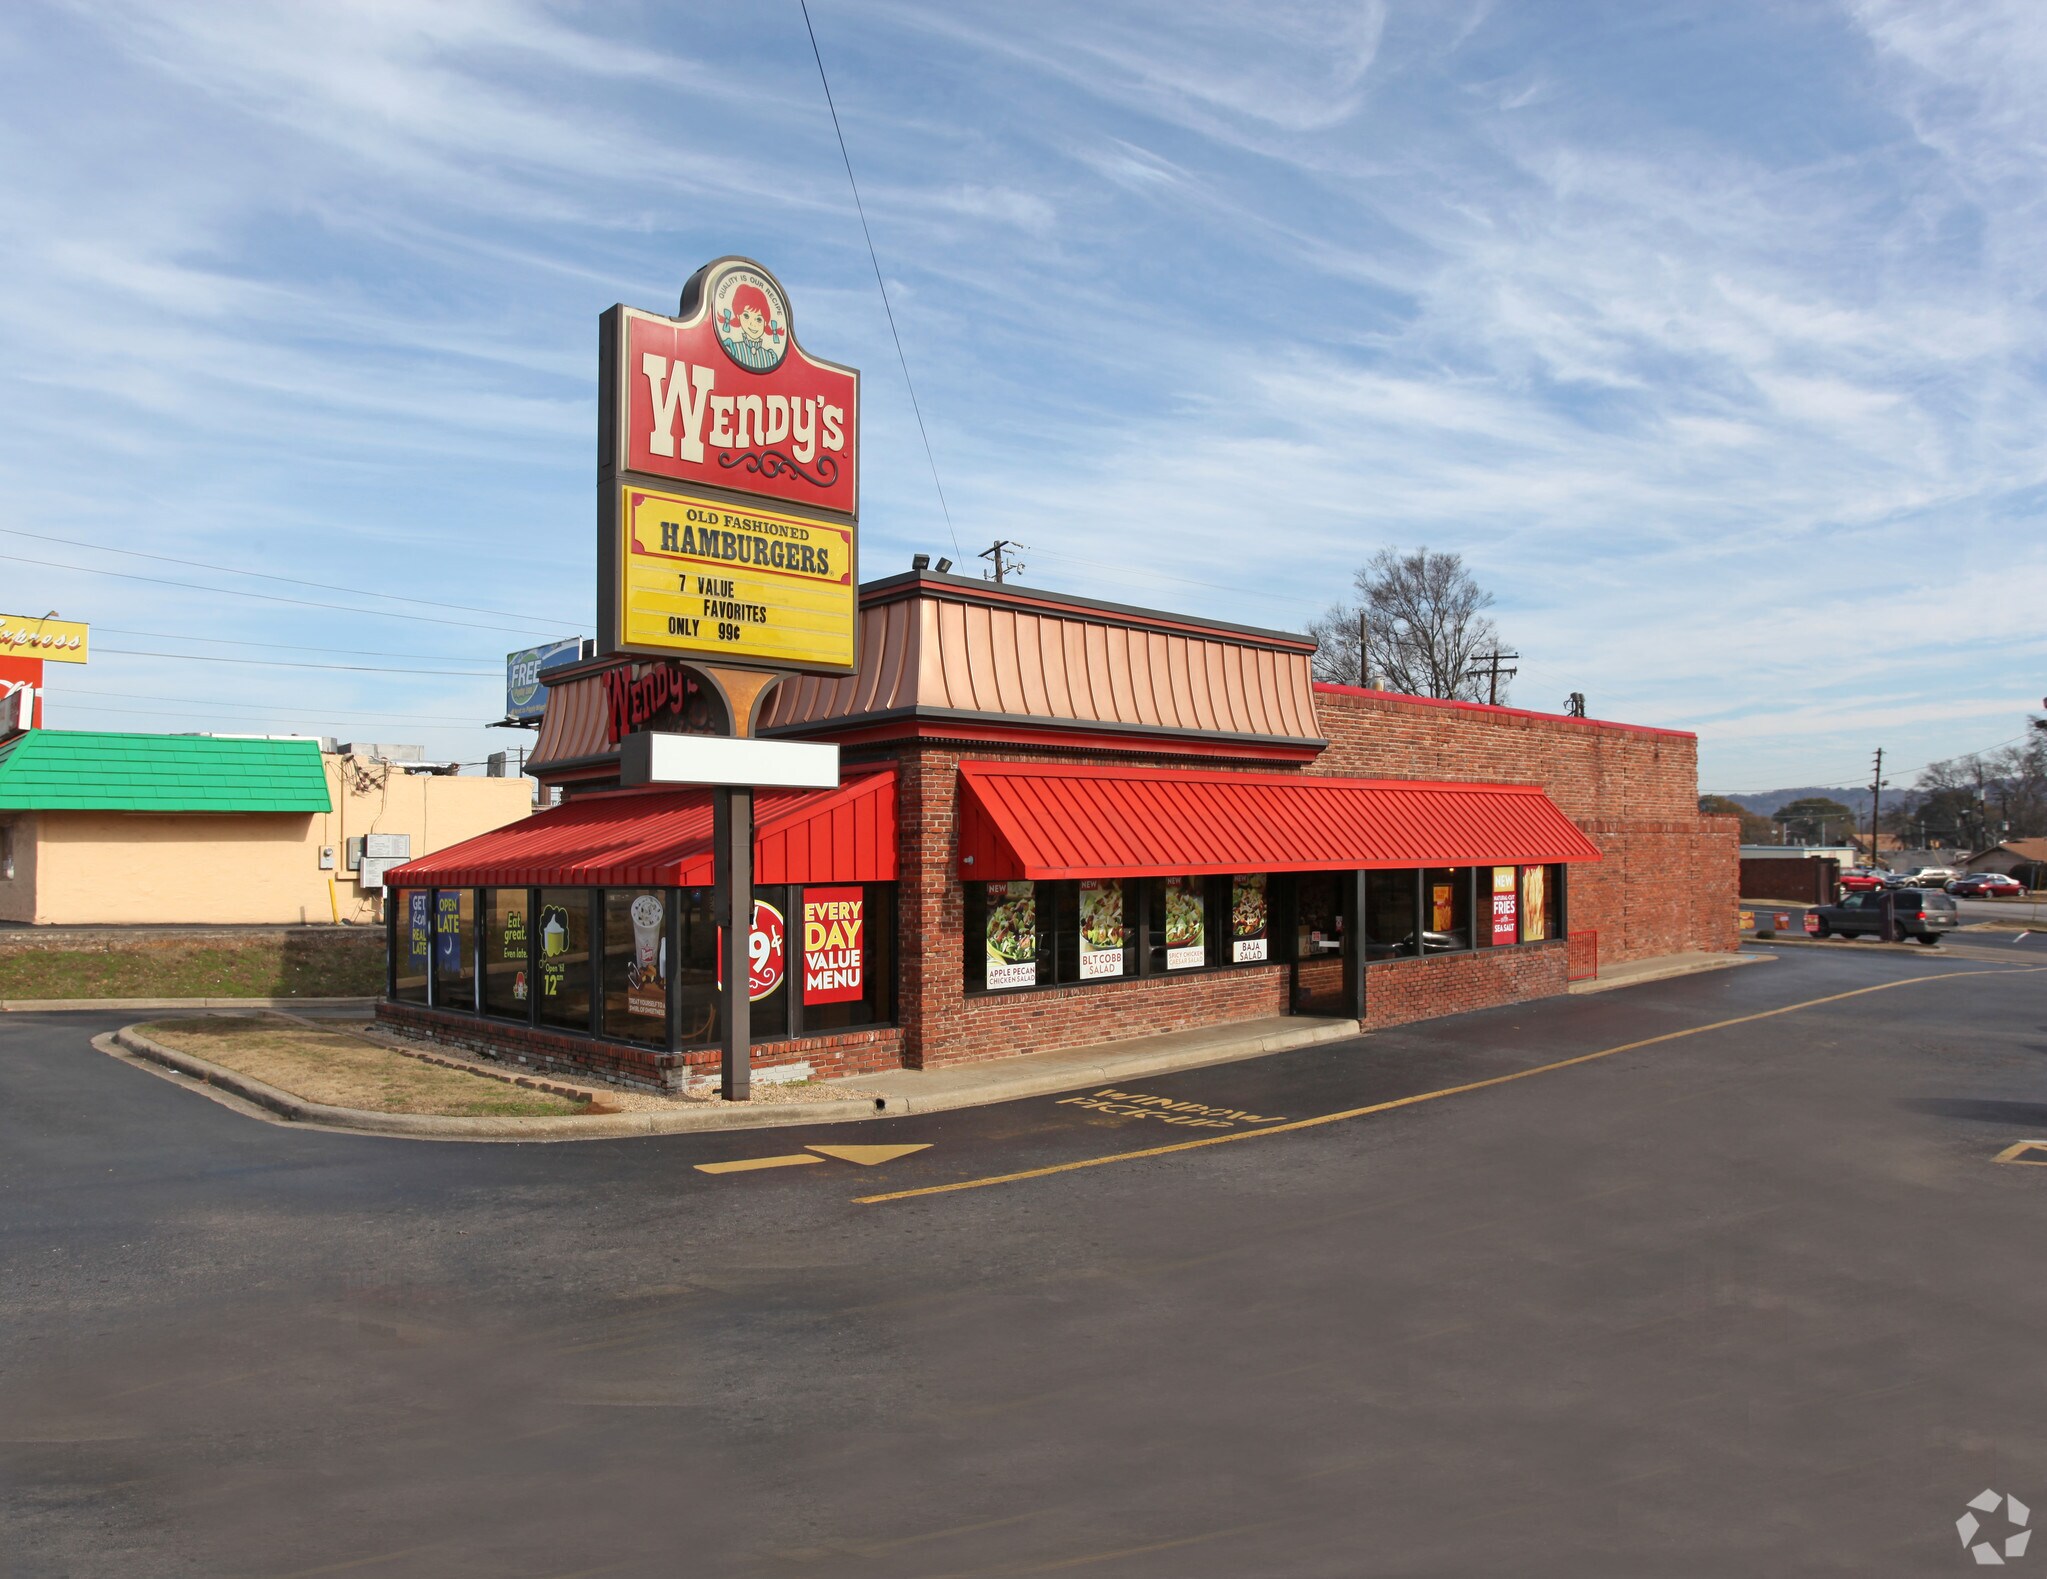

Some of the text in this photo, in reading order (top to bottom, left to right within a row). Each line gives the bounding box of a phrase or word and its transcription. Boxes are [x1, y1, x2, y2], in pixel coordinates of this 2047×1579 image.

[718, 275, 738, 299] QUALITY
[749, 276, 764, 289] OUR
[765, 288, 783, 316] RECIPE
[642, 352, 845, 464] Wendy's
[686, 508, 810, 541] OLD FASHIONED
[660, 521, 830, 575] HAMBURGERS
[678, 574, 735, 599] 7 VALUE
[704, 599, 767, 624] FAVORITES
[668, 616, 740, 641] ONLY 99¢
[511, 659, 542, 688] FREE
[988, 884, 1007, 893] NEW
[1081, 880, 1097, 888] NEW
[1167, 877, 1181, 885] NEW
[1495, 874, 1513, 888] NEW
[412, 895, 426, 910] GET
[439, 898, 457, 911] OPEN
[1493, 900, 1516, 915] FRIES
[804, 900, 863, 922] EVERY
[437, 914, 460, 933] LATE
[507, 912, 521, 928] Eat
[412, 928, 427, 941] REAL
[504, 925, 527, 945] great.
[804, 919, 863, 952] DAY
[1494, 923, 1515, 933] SEA SALT
[412, 941, 427, 956] LATE
[503, 947, 529, 959] Even late.
[1242, 941, 1261, 952] BAJA
[805, 949, 861, 971] VALUE
[1082, 952, 1122, 966] BLT COBB
[1168, 950, 1204, 960] SPICY CHICKEN
[1188, 956, 1204, 964] SALAD
[1239, 950, 1263, 961] SALAD
[545, 963, 558, 974] Open
[989, 966, 1035, 978] APPLE PECAN
[1089, 963, 1115, 975] SALAD
[806, 968, 861, 991] MENU
[989, 974, 1035, 985] CHICKEN SALAD
[1055, 1096, 1235, 1128] PICK-UP
[1093, 1088, 1288, 1123] WINDOW
